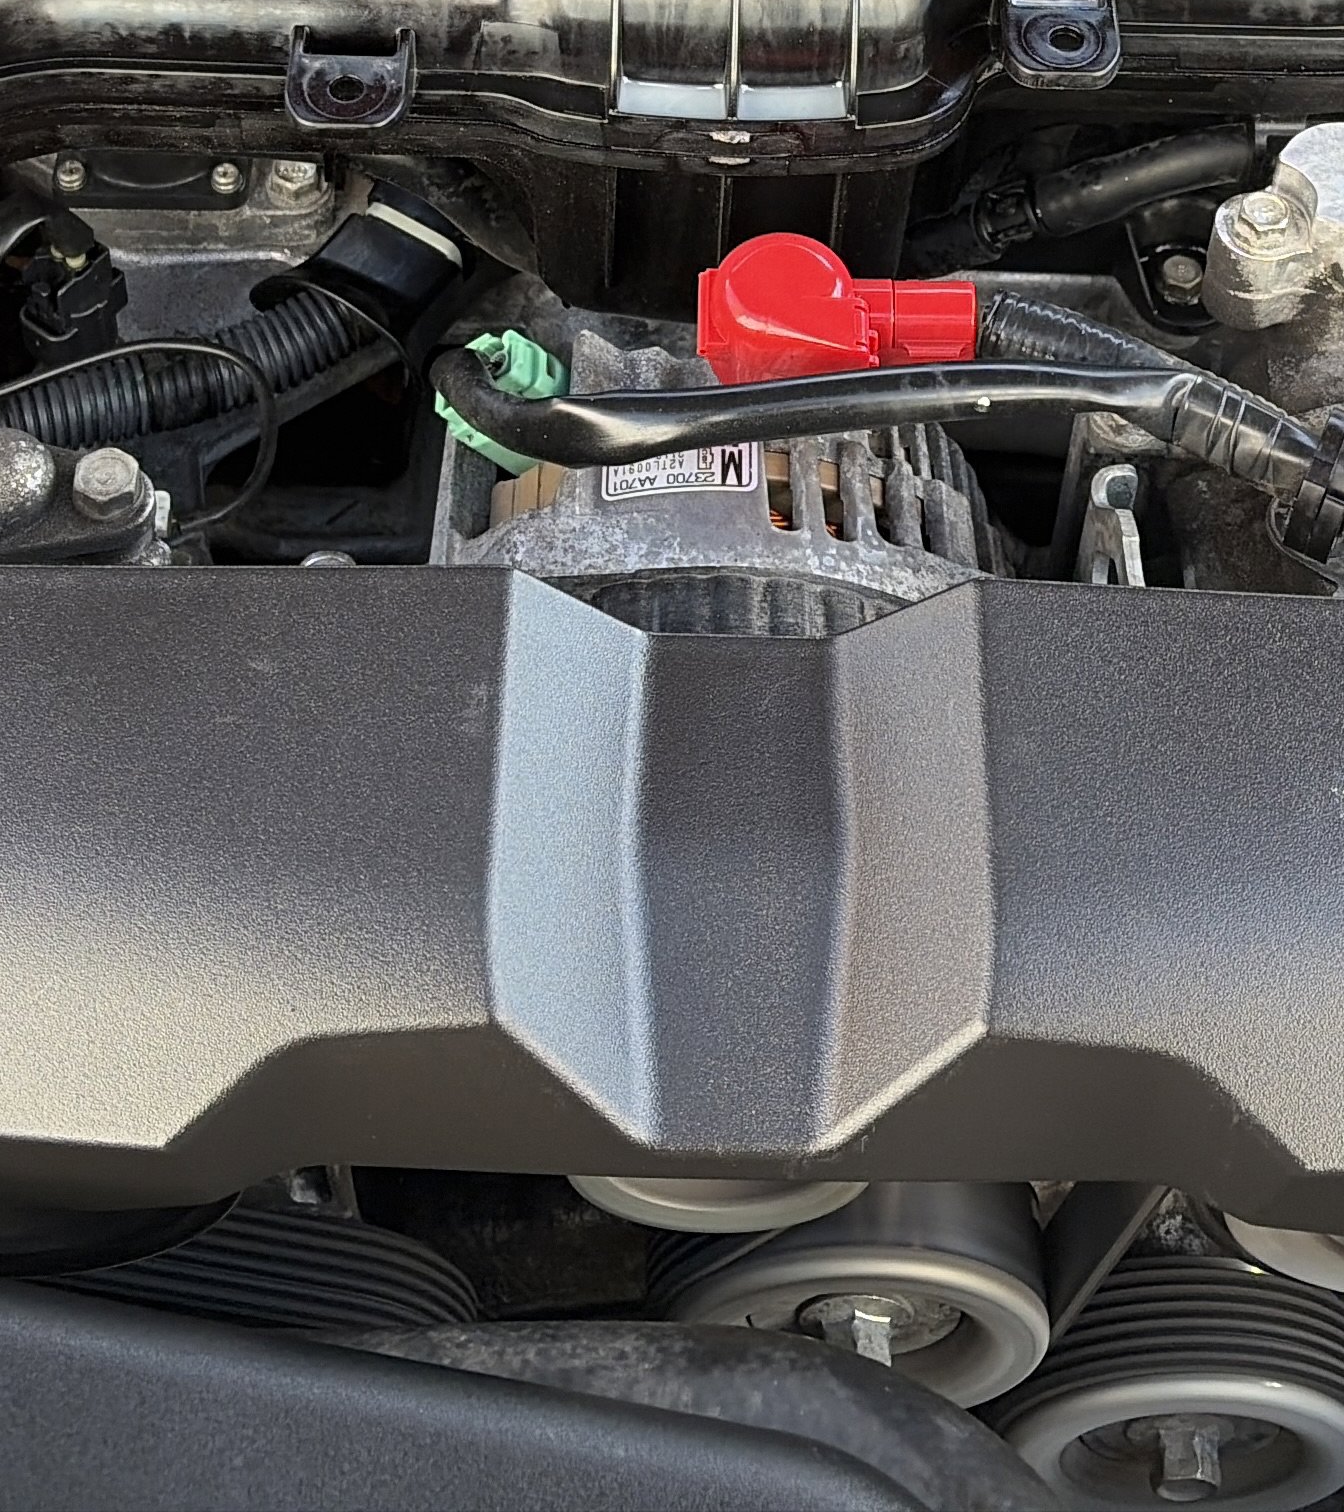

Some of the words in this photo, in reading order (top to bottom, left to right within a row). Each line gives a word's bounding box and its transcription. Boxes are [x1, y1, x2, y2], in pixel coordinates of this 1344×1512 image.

[720, 448, 743, 486] M
[613, 475, 658, 493] AA701
[666, 471, 716, 485] 23700
